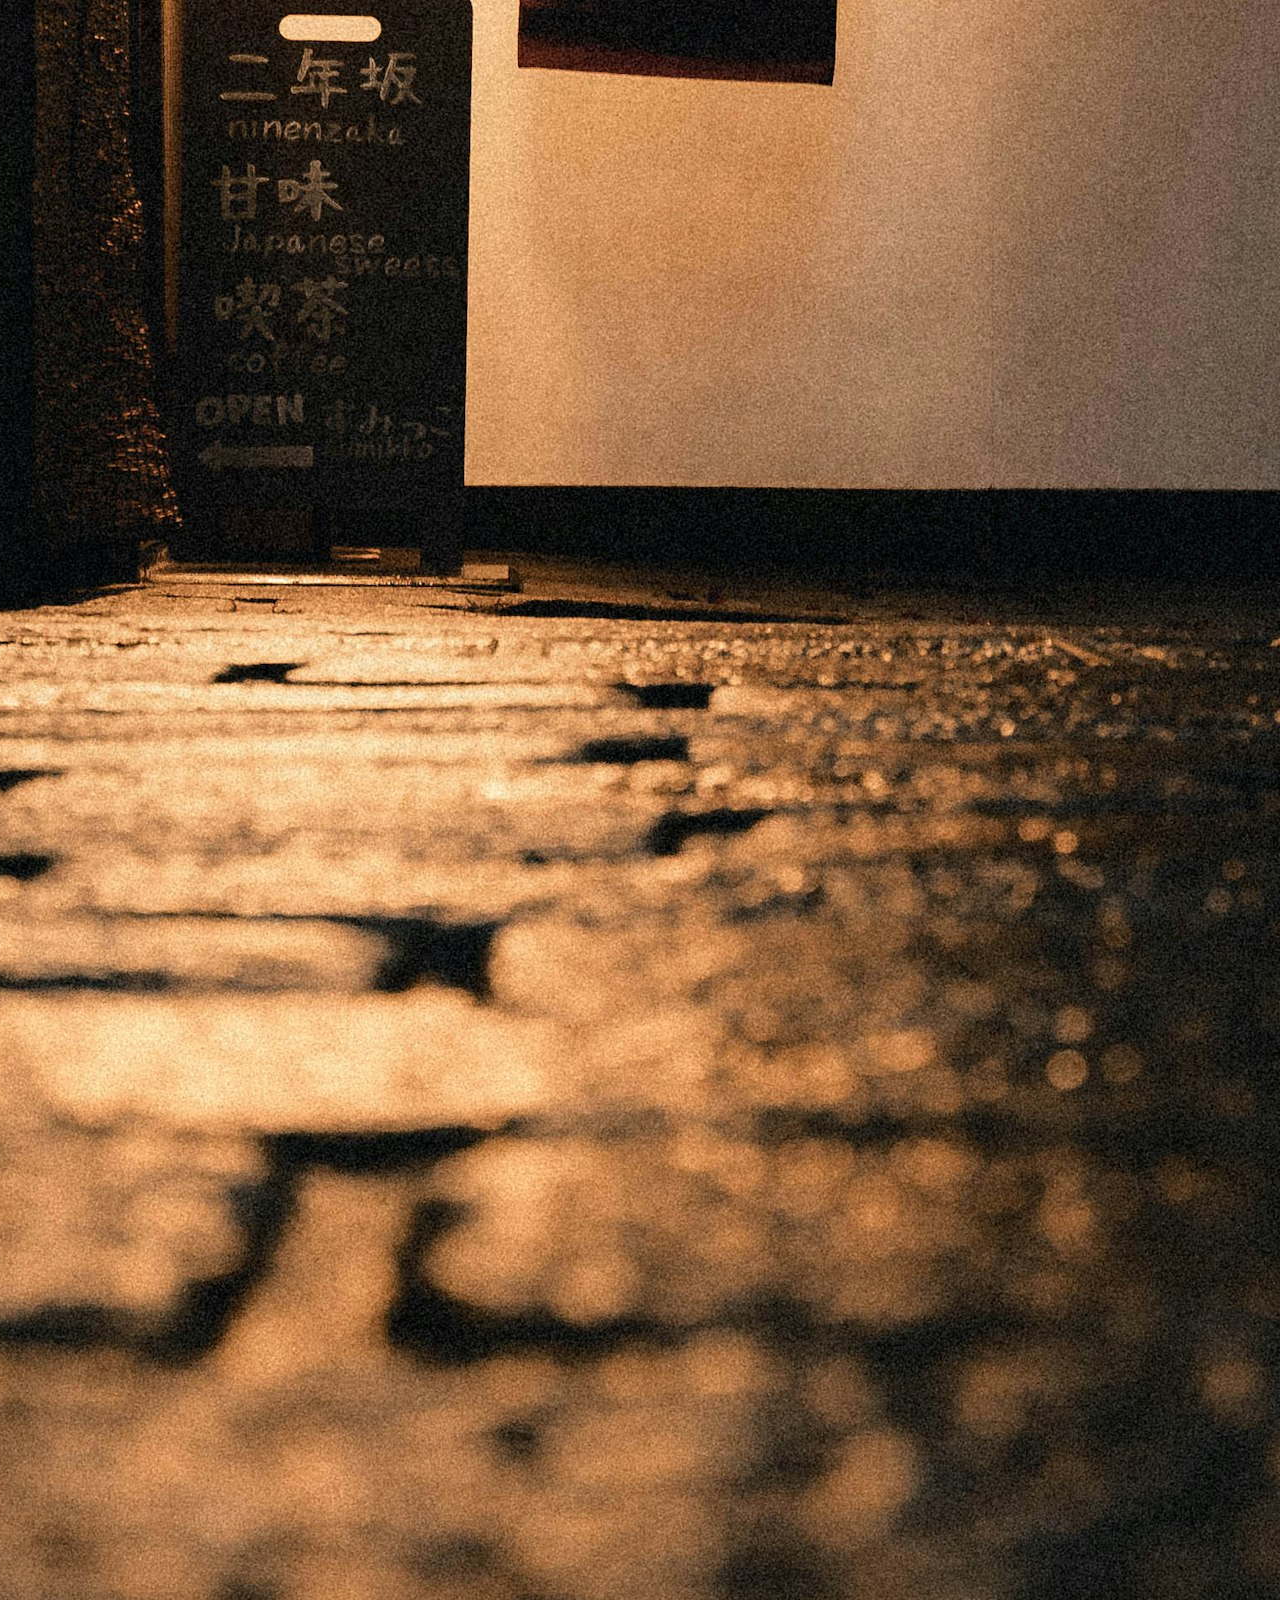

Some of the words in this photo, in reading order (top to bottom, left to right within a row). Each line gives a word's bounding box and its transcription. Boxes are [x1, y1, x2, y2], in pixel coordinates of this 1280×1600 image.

[218, 47, 424, 108] 二年坂
[227, 110, 405, 146] ninenzaka
[214, 159, 344, 222] 甘味
[223, 224, 387, 257] Japanese
[334, 254, 460, 279] sweets
[214, 275, 350, 343] 喫茶
[194, 391, 305, 430] OPEN
